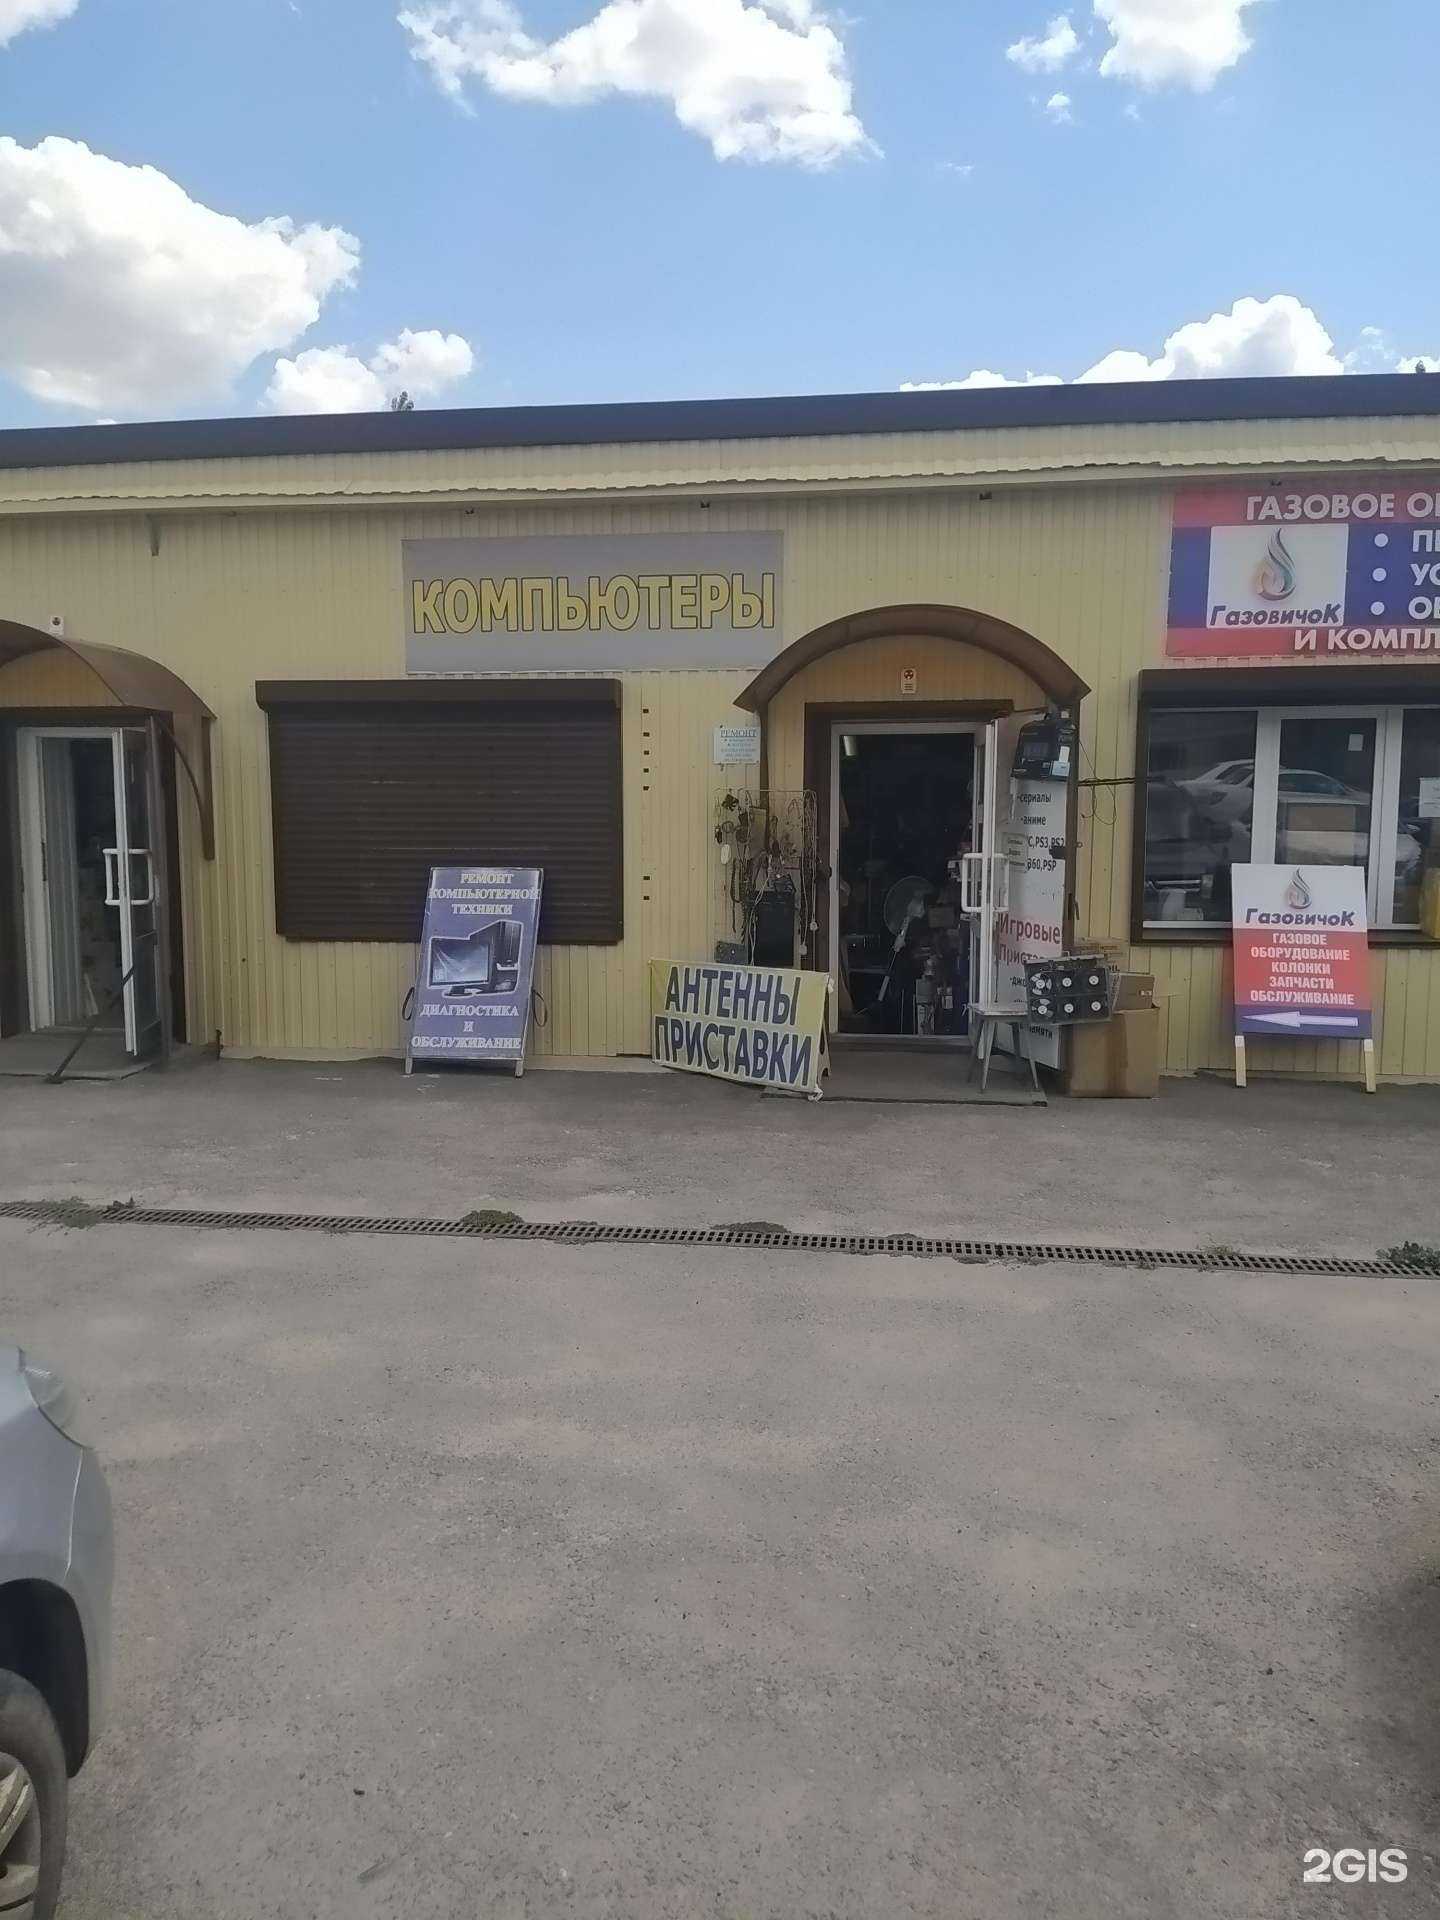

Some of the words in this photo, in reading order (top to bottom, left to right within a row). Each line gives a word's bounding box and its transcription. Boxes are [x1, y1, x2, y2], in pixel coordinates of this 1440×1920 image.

[1246, 493, 1395, 521] ГАЗОВОЕ
[412, 573, 775, 634] КОМПЬЮТЕРЫ
[1294, 629, 1317, 651] И
[1327, 628, 1440, 650] КОМПЛ
[460, 873, 514, 884] РЕМОНТ
[429, 887, 540, 899] КОМПЬЮТЕРНОЙ
[451, 903, 513, 915] ТЕХНИКИ
[999, 912, 1061, 944] Игровые
[1272, 933, 1327, 945] ГАЗОВОЕ
[1250, 947, 1350, 961] ОБОРУДОВАНИЕ
[1271, 962, 1331, 975] КОЛОНКИ
[1269, 976, 1335, 989] ЗАПЧАСТИ
[665, 966, 801, 1026] АНТЕННЫ
[1250, 990, 1355, 1005] ОБСЛУЖИВАНИЕ
[420, 1004, 519, 1017] ДИАГНОСТИКА
[463, 1021, 474, 1032] И
[411, 1036, 521, 1049] ОБСЛУЖИВАНИЕ
[654, 1016, 812, 1086] ПРИСТАВКИ
